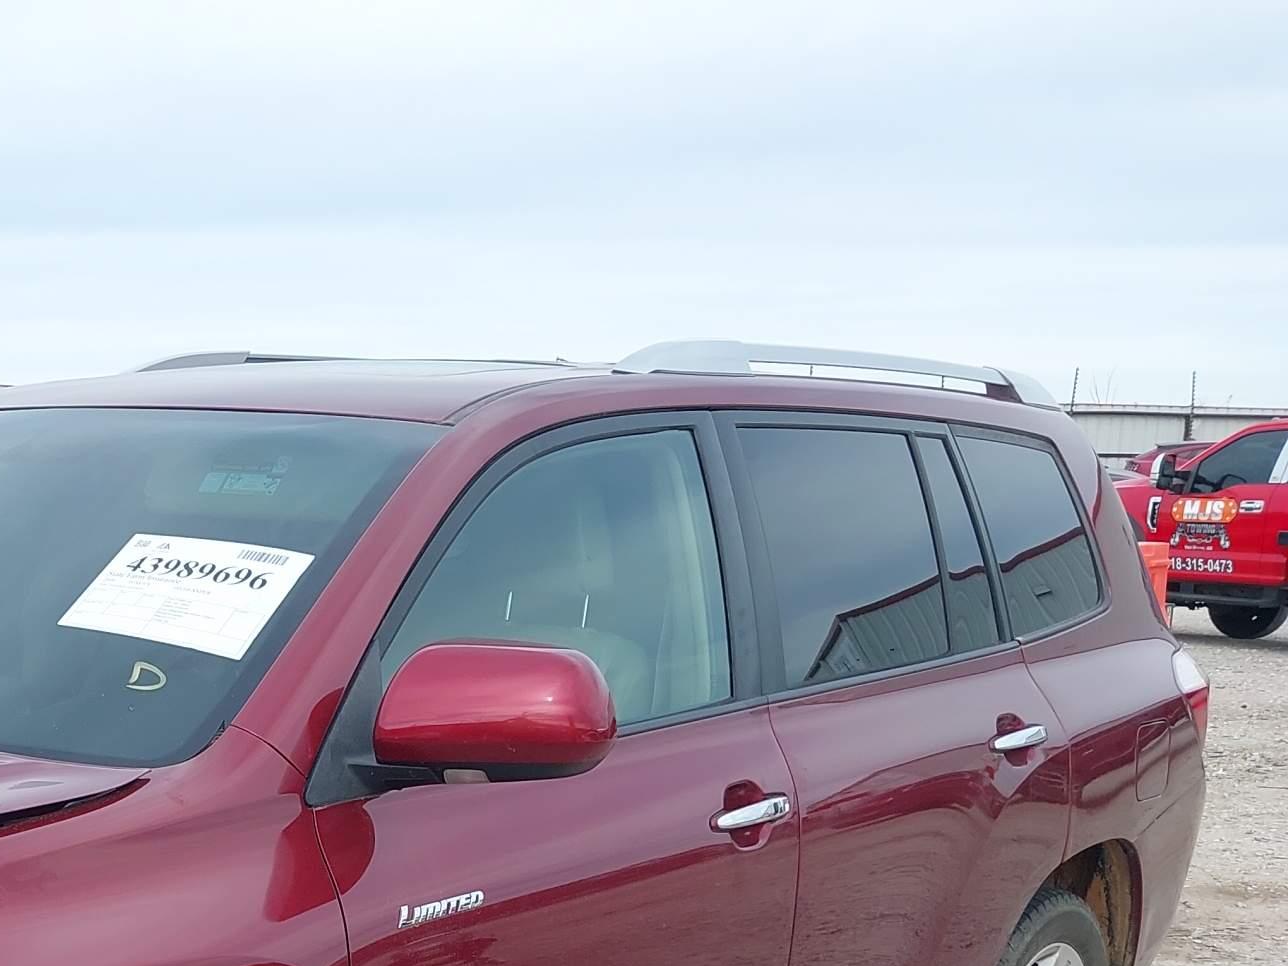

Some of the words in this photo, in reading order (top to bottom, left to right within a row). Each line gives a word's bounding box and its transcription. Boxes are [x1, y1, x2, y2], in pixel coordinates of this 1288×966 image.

[1183, 500, 1224, 521] MJS
[126, 556, 274, 590] 43989696
[1167, 558, 1233, 573] 18-315-0473
[126, 661, 167, 691] D
